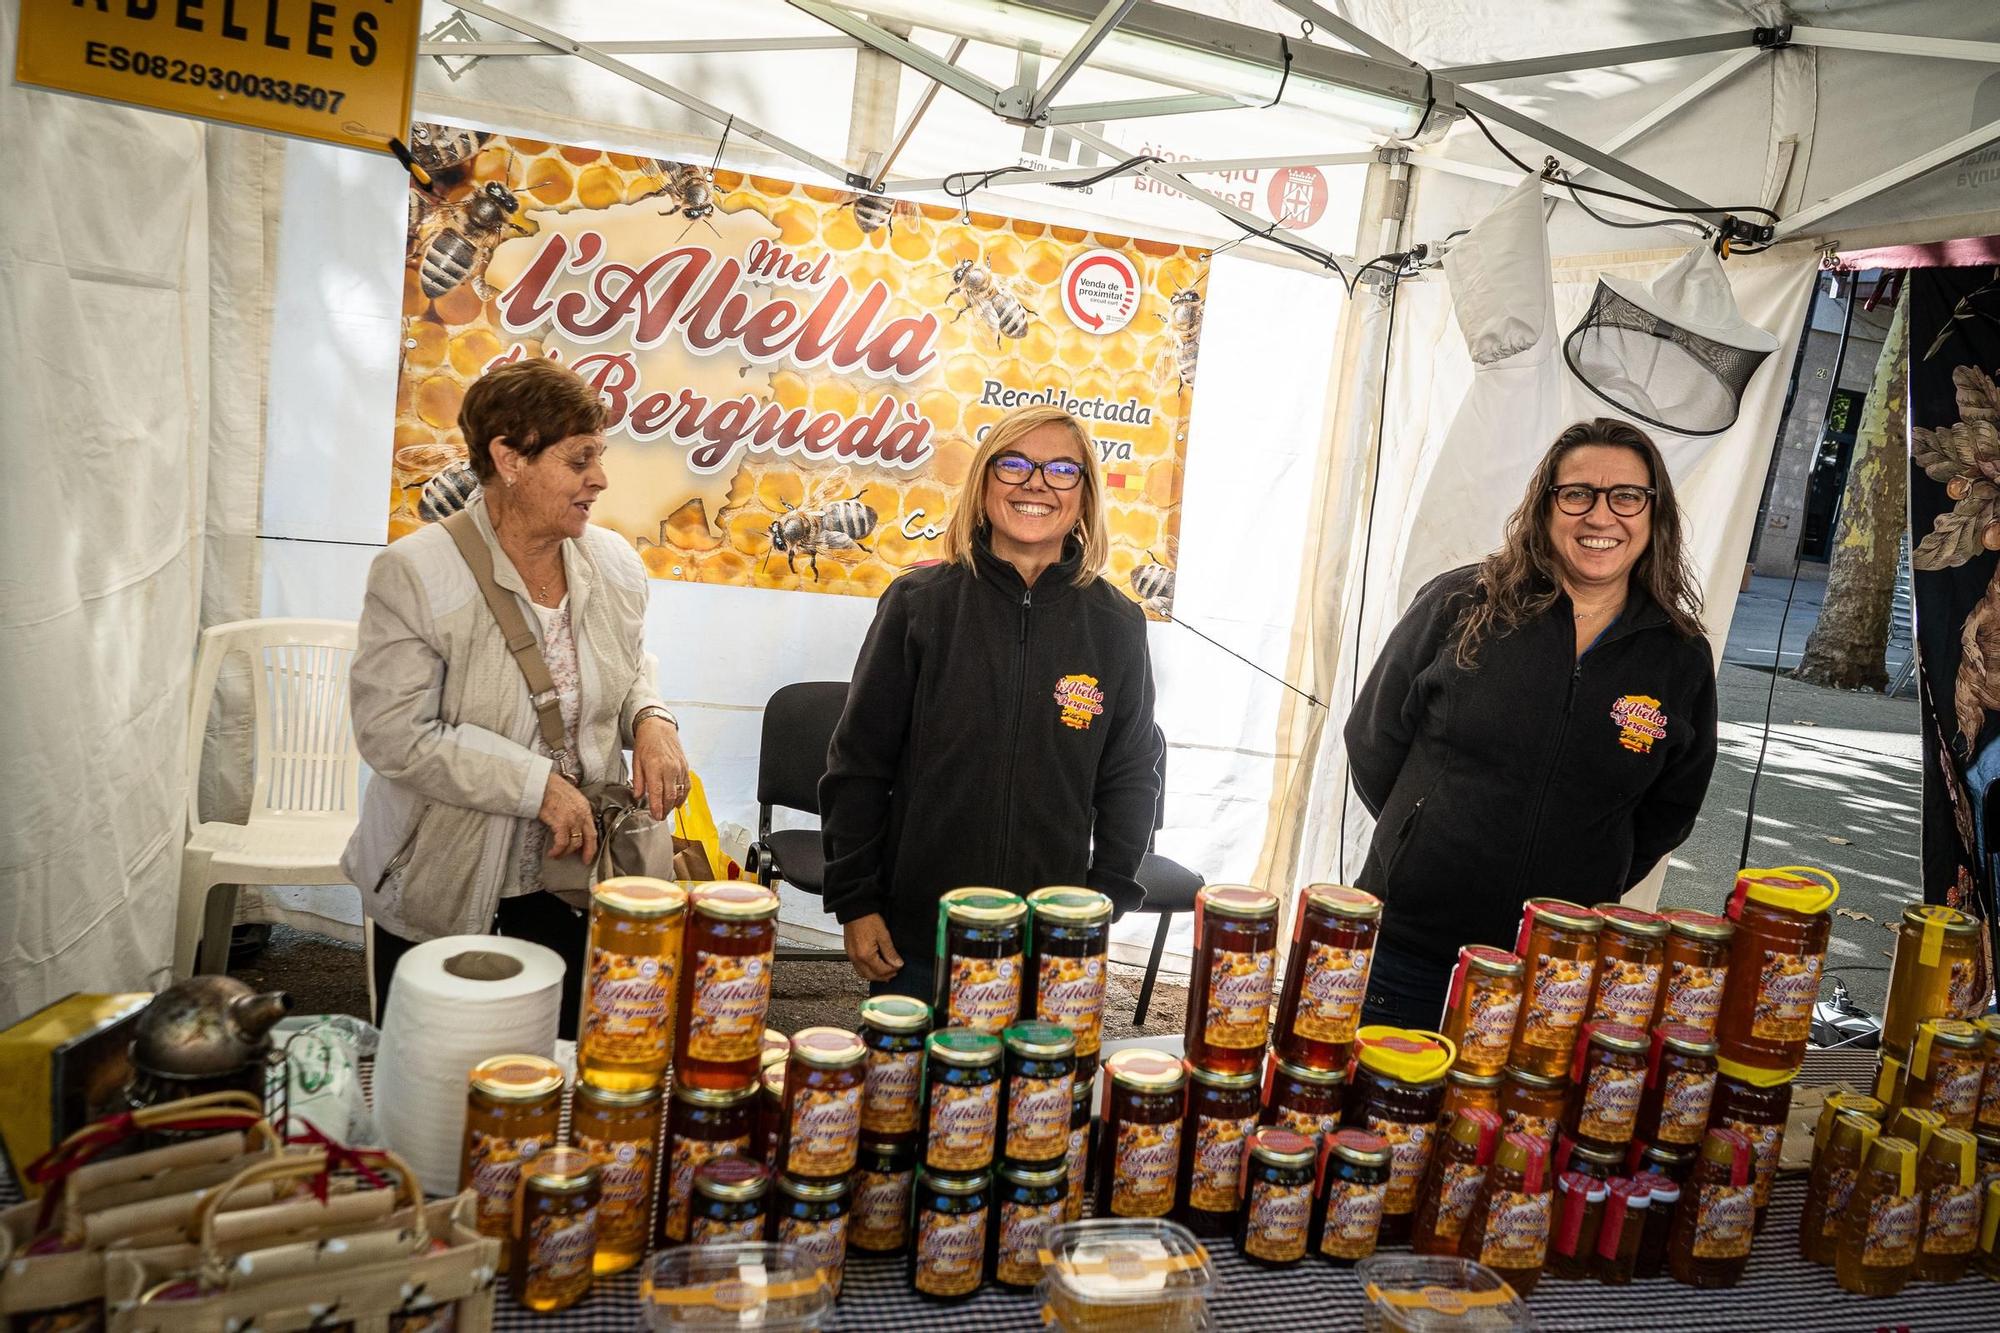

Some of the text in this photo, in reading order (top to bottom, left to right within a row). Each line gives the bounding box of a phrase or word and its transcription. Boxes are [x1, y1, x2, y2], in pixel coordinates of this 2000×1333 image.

[84, 41, 346, 115] ES082930033507
[749, 239, 832, 284] Mel
[502, 232, 938, 376] l'Abella
[1079, 288, 1123, 301] proximitat
[1080, 278, 1119, 291] Venda de
